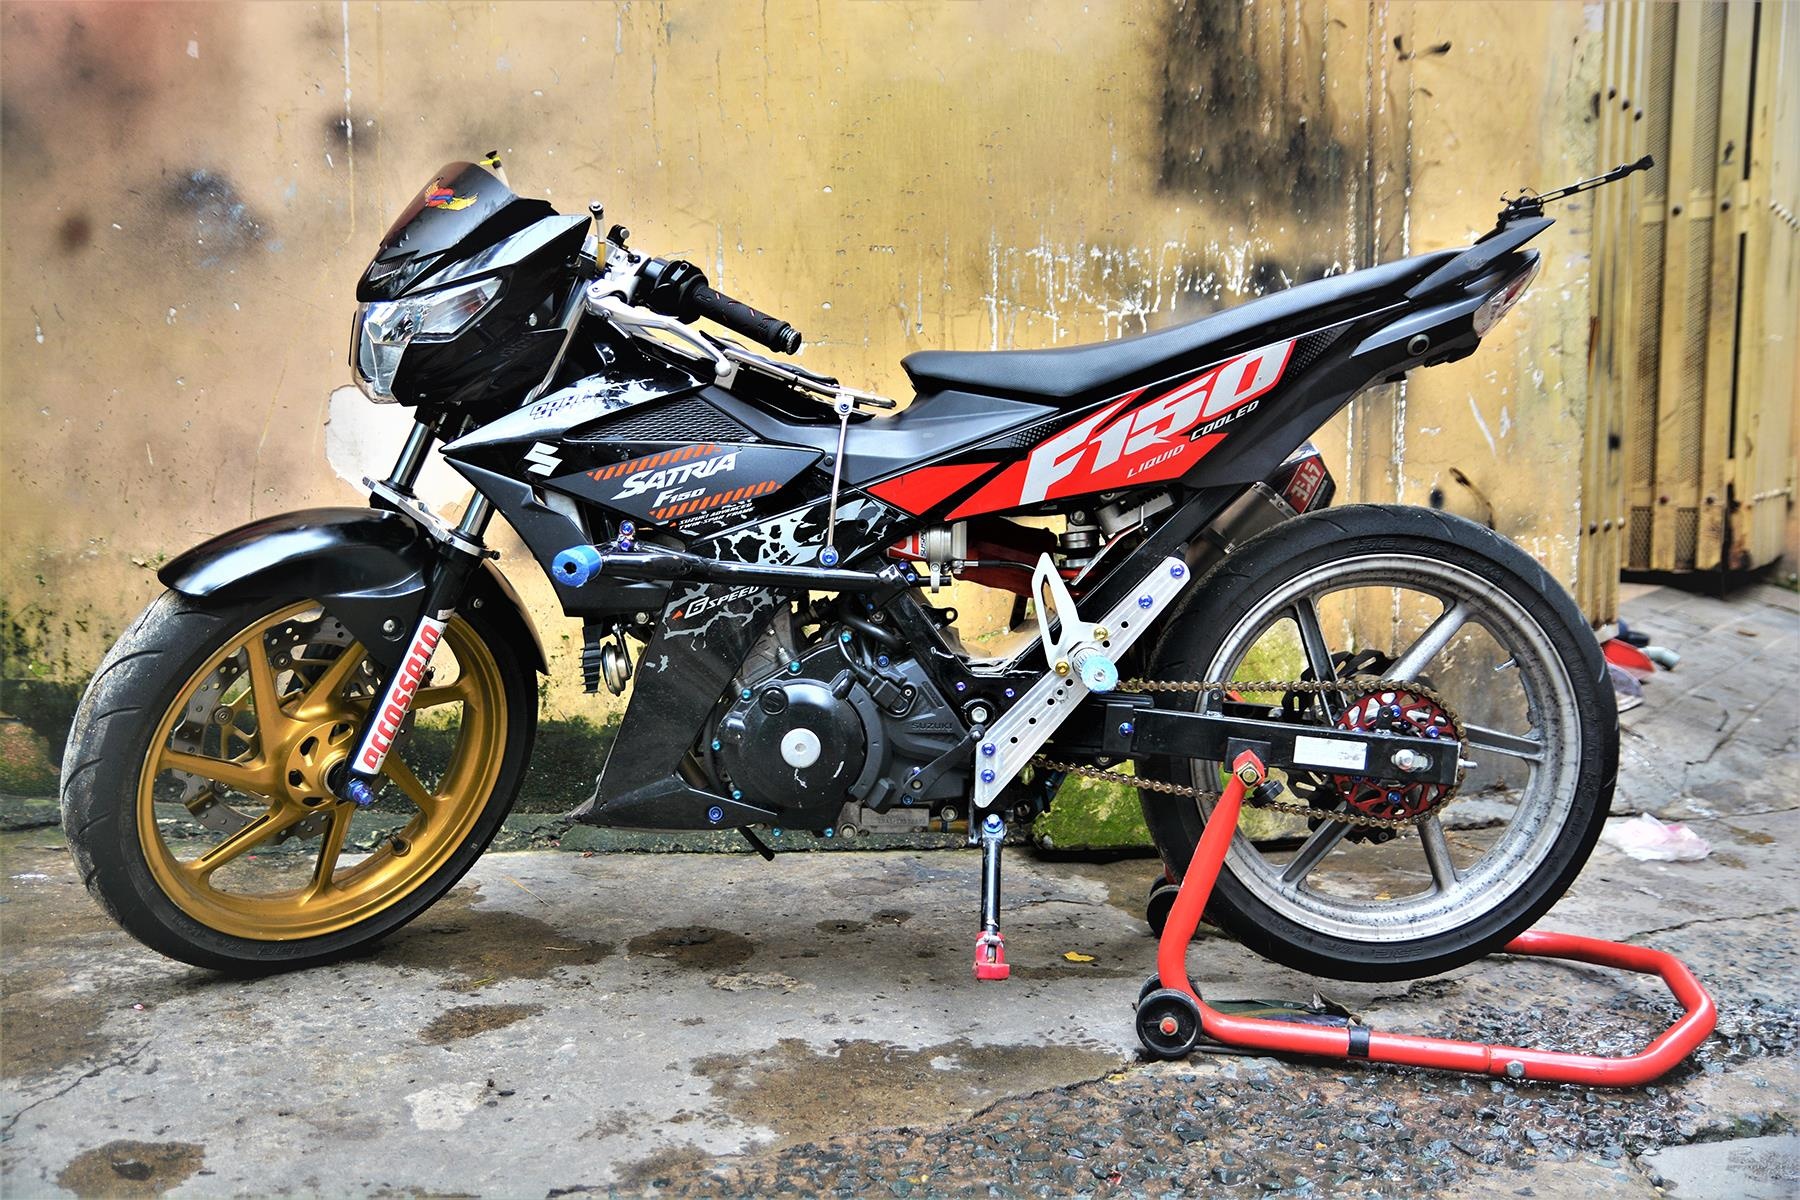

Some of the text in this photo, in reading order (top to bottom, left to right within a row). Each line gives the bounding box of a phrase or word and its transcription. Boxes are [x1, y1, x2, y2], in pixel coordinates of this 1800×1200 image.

[1019, 339, 1292, 506] F150
[1127, 399, 1260, 479] LIQUID COOLED
[611, 450, 743, 500] SATRIA
[652, 486, 707, 508] F150
[680, 502, 753, 525] SUZUKI ADVANCED
[726, 506, 756, 518] FRAME
[912, 721, 953, 732] SUZUKI
